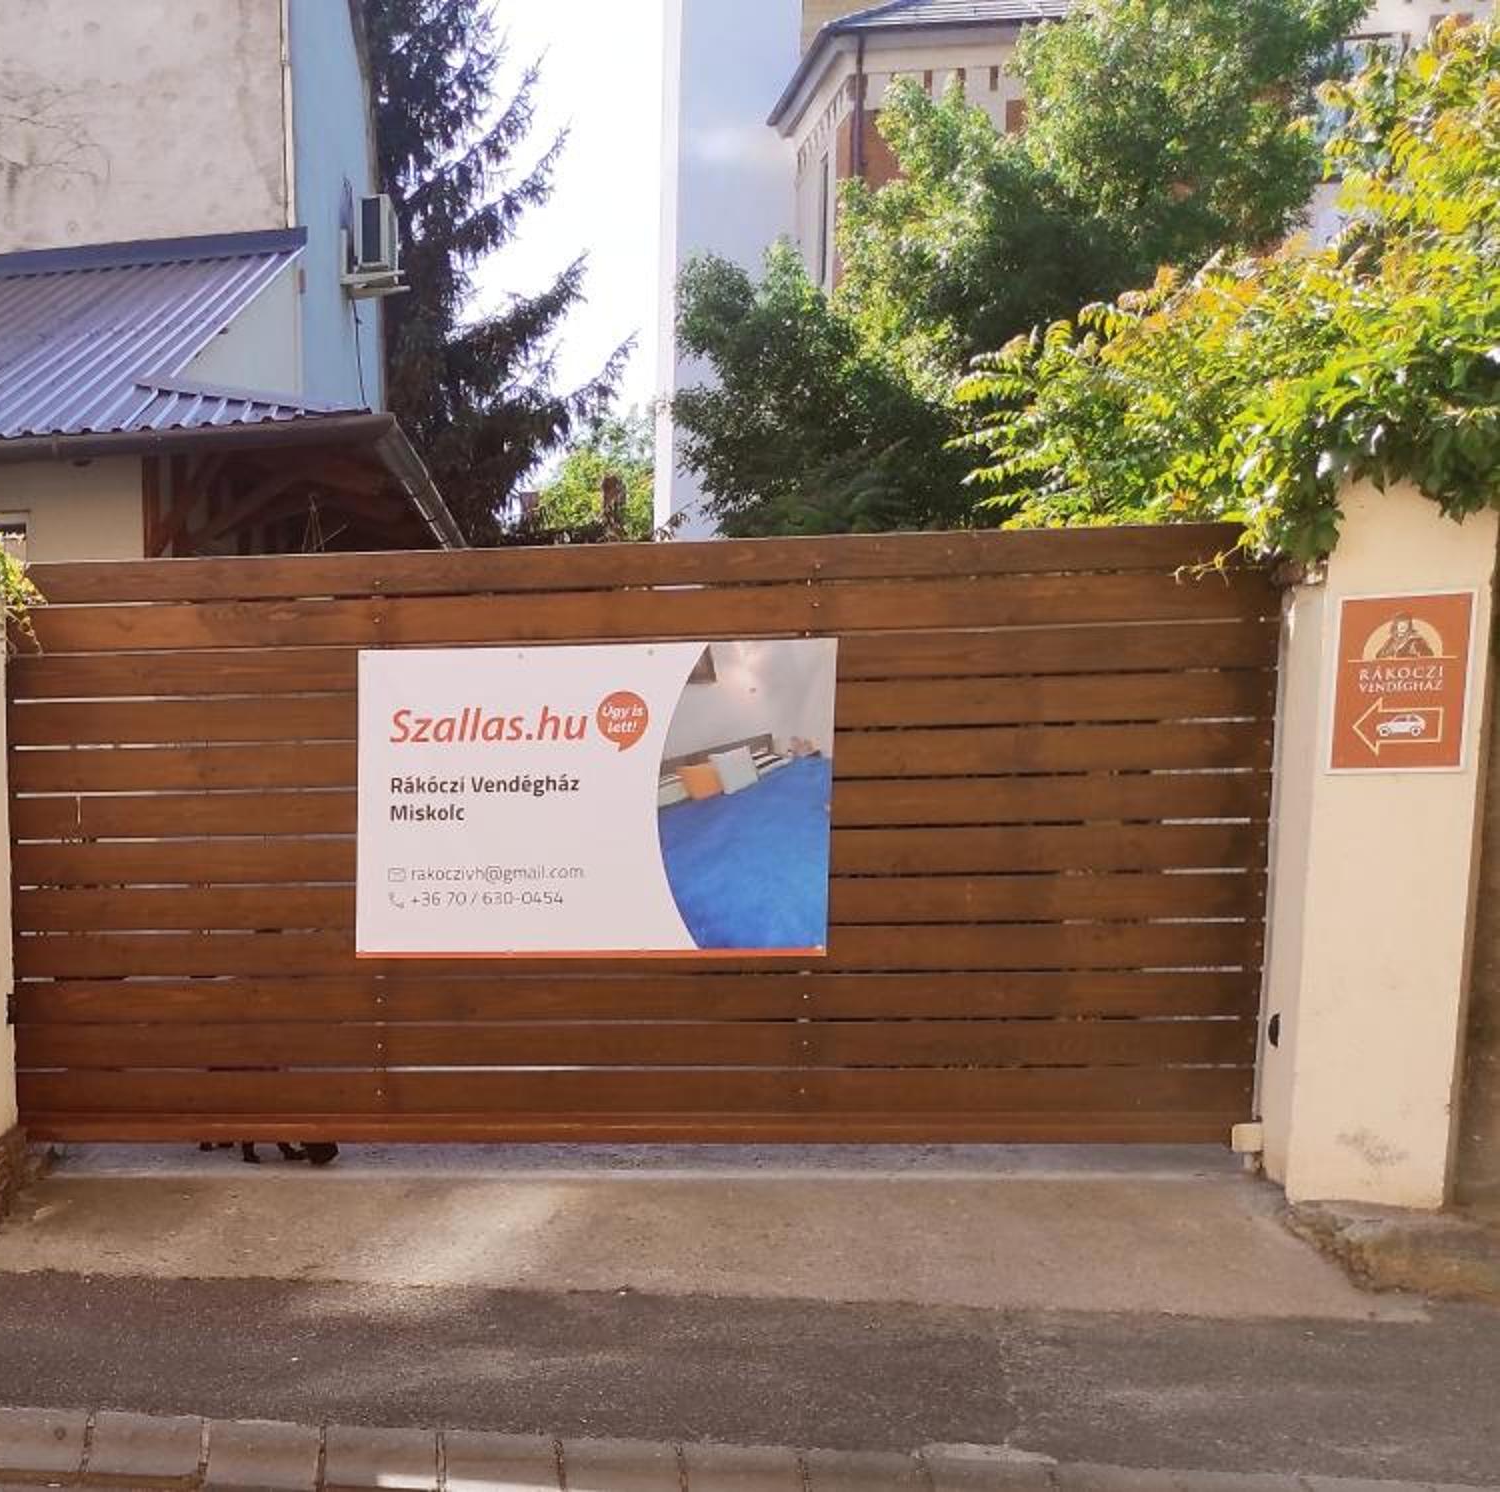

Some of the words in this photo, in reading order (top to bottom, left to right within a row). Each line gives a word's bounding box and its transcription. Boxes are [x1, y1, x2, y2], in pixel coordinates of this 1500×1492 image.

[631, 703, 645, 717] is
[388, 705, 589, 743] Szallas.hu
[390, 776, 465, 794] Rákóczi
[471, 773, 581, 796] Vendégház
[389, 803, 465, 822] Miskolc
[411, 865, 585, 884] rakoczivh@gmail.com
[410, 891, 440, 906] +36
[446, 891, 467, 906] 70
[482, 890, 564, 906] 630-0454
